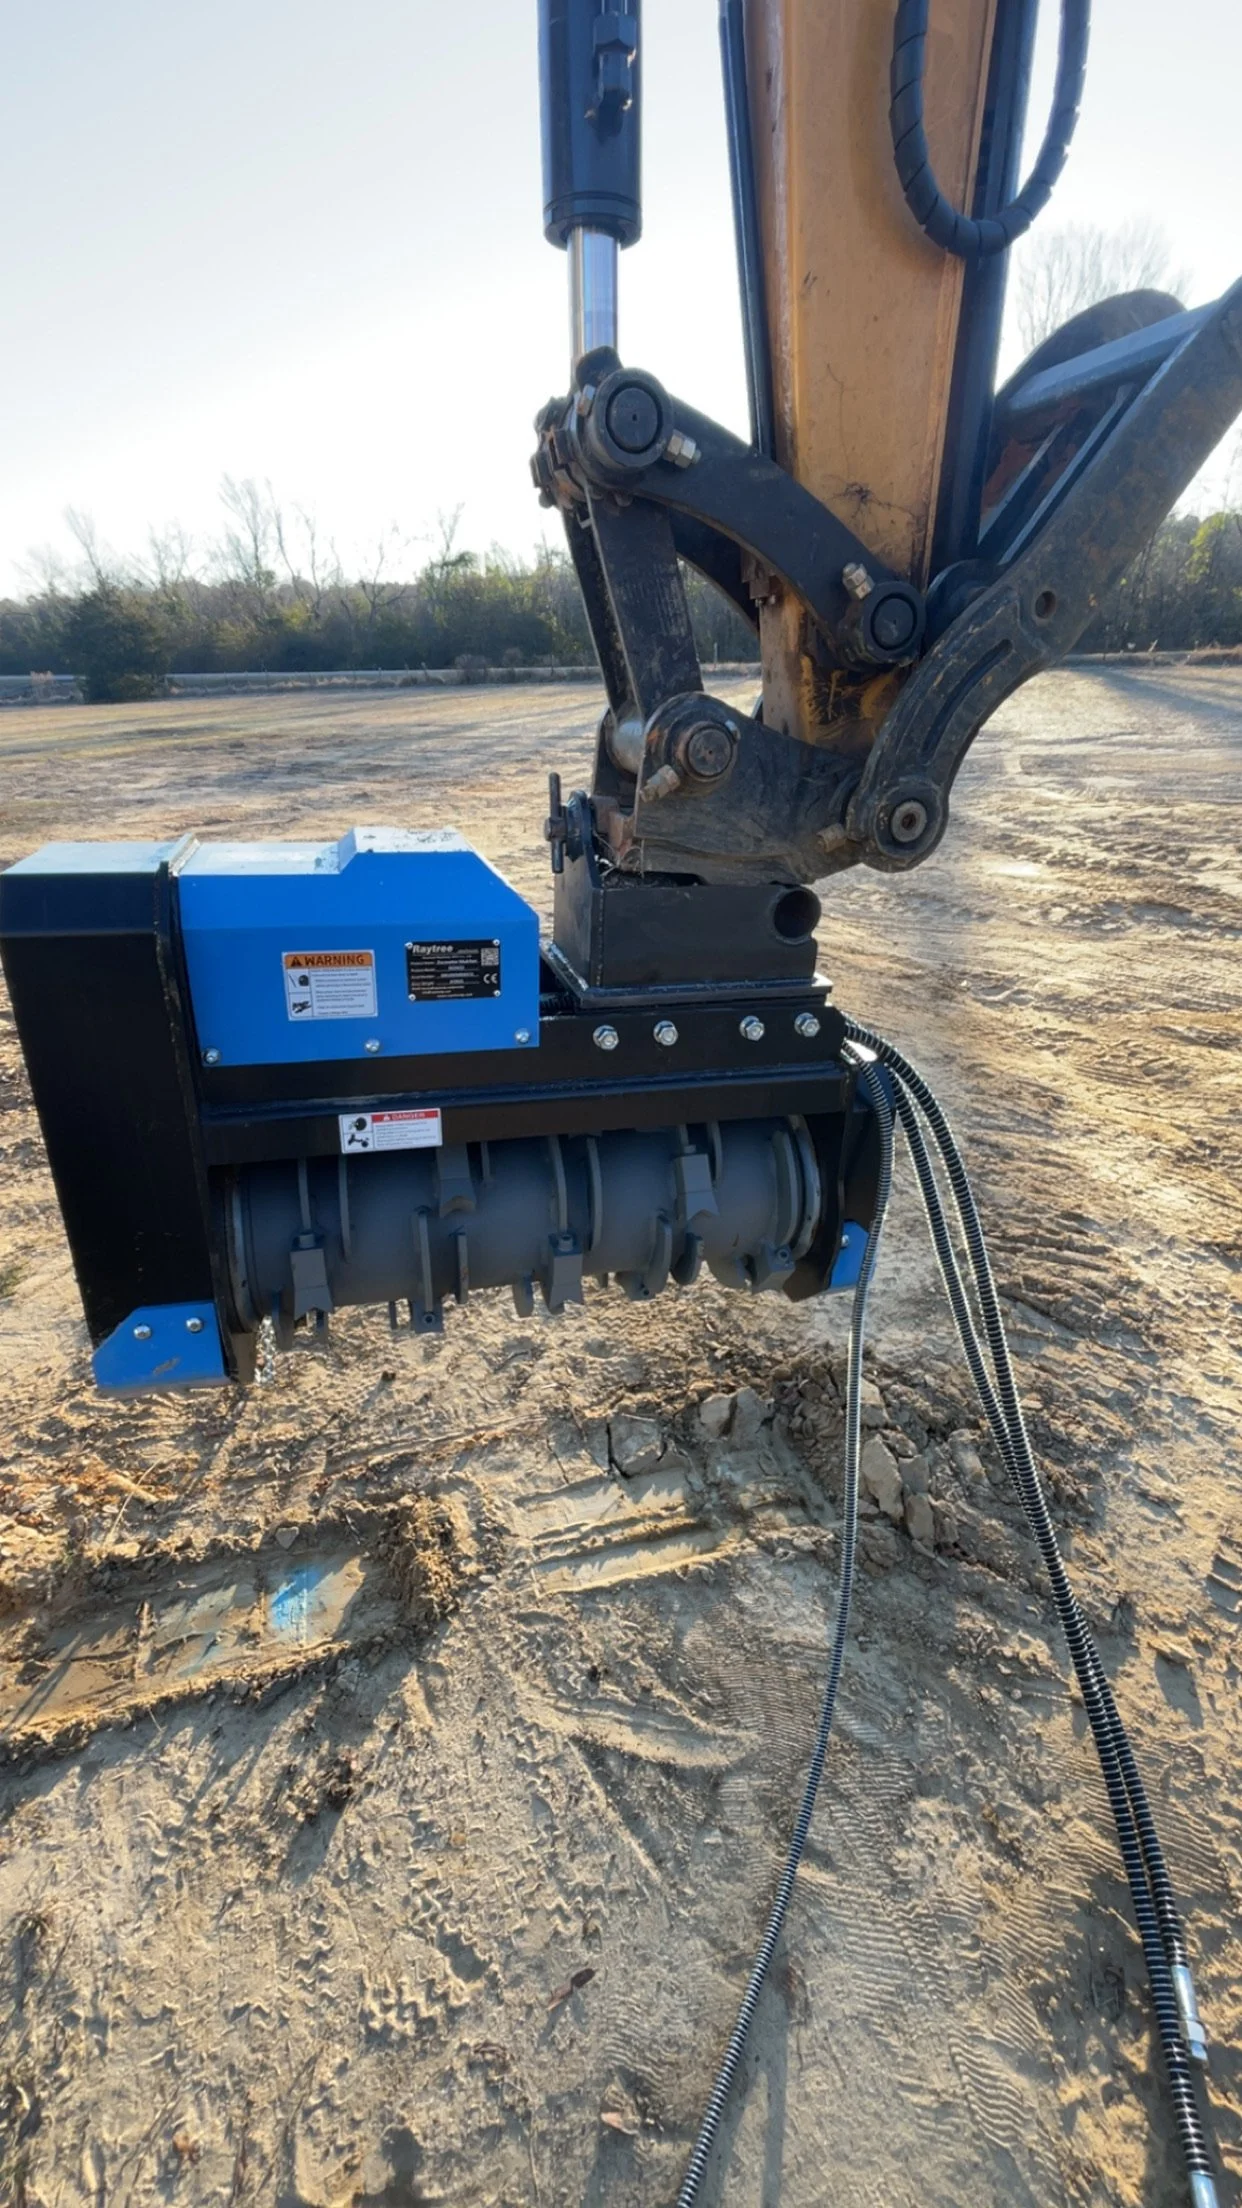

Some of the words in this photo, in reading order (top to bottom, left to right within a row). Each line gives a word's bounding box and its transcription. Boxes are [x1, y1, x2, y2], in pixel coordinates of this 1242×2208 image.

[412, 944, 454, 956] Raytree
[304, 954, 365, 966] WARNING
[483, 973, 498, 984] CE
[391, 1111, 426, 1121] DANGER
